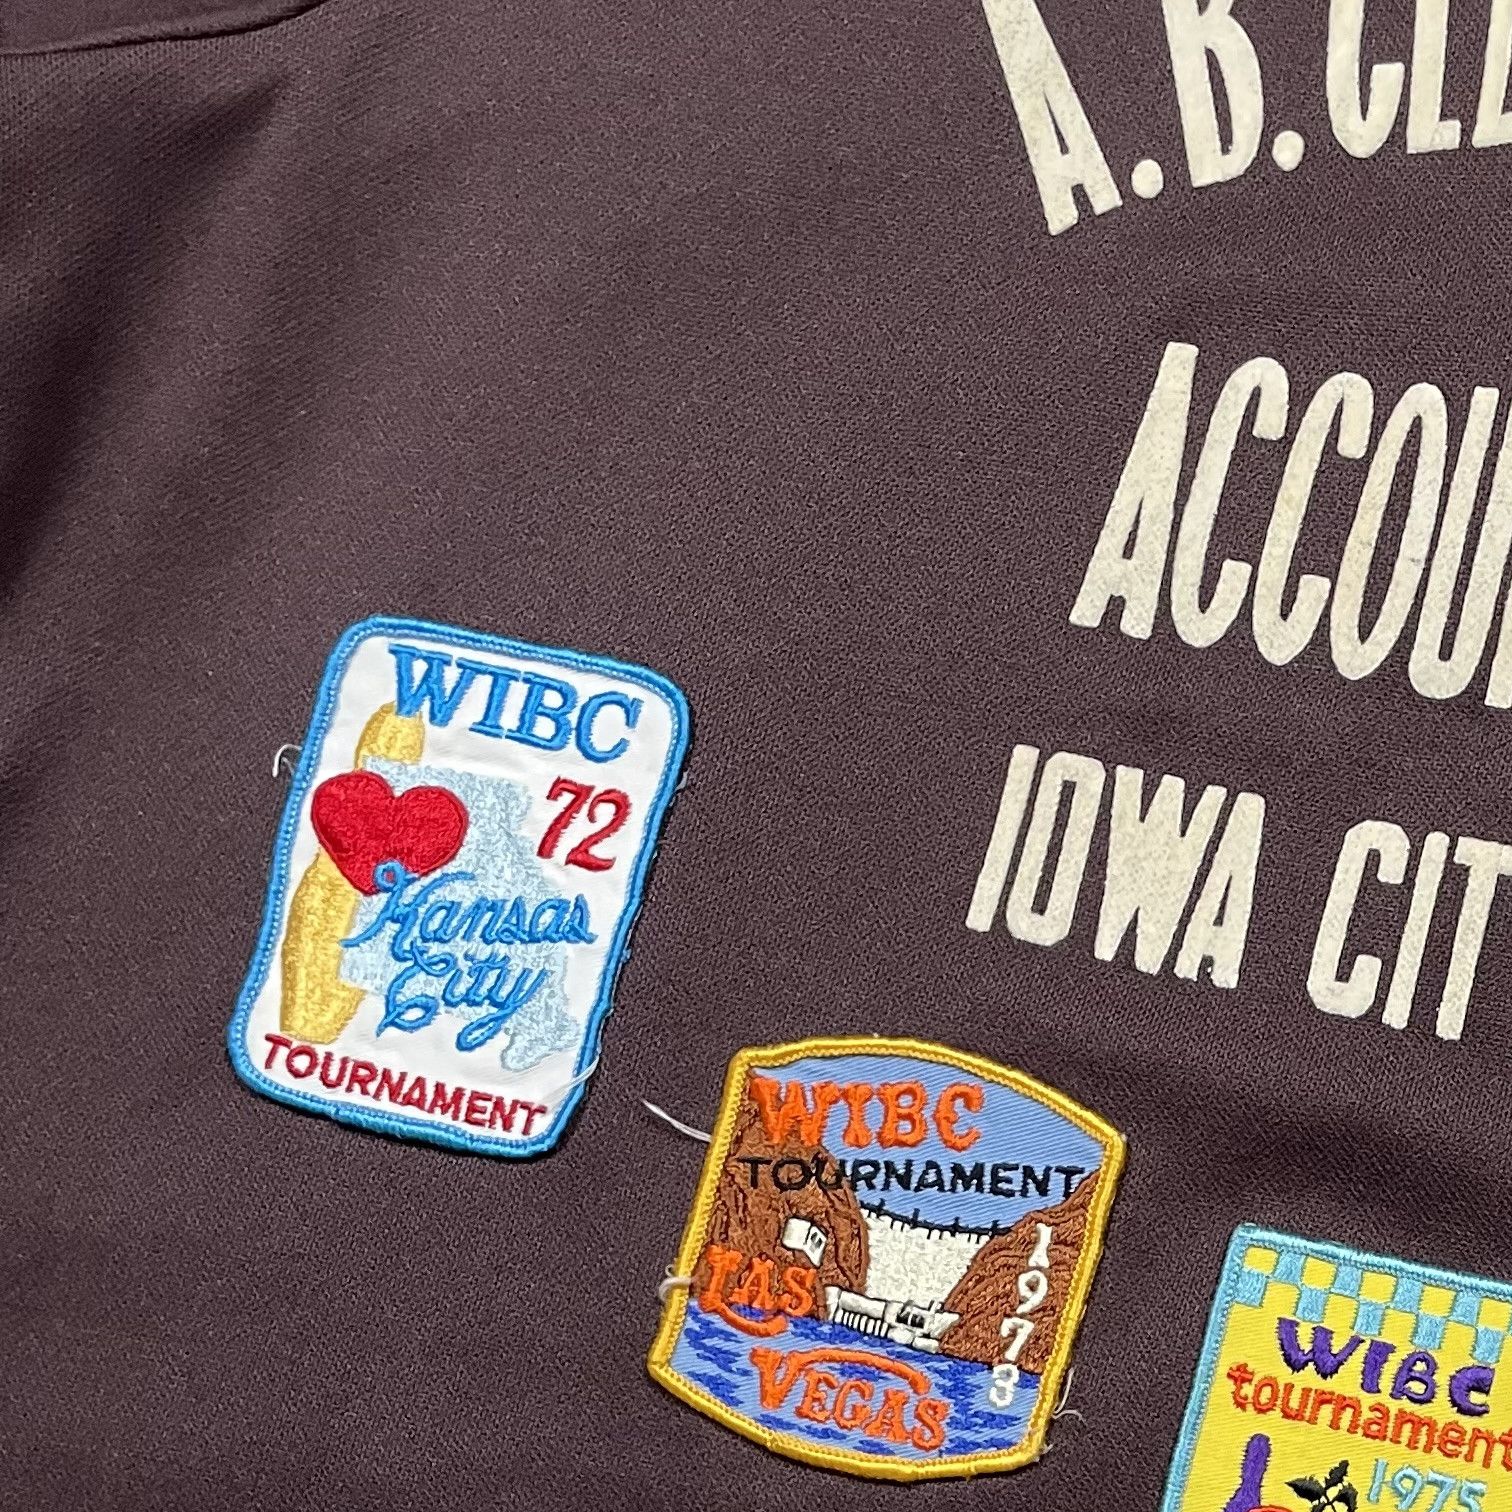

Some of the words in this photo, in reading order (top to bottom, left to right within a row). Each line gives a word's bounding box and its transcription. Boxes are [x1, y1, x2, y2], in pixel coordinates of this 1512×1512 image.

[980, 0, 1164, 236] A.
[388, 643, 642, 764] WIBC
[536, 775, 632, 872] 72
[966, 743, 1266, 988] IOWA
[341, 860, 598, 963] Kansas
[376, 941, 556, 1053] City
[264, 1032, 548, 1137] TOURNAMENT
[749, 1077, 985, 1153] WIBC
[735, 1156, 1086, 1200] TOURNAMENT
[697, 1244, 818, 1338] LAS
[987, 1223, 1056, 1409] 1973
[748, 1347, 951, 1452] VEGAS
[1277, 1316, 1496, 1416] WIBC
